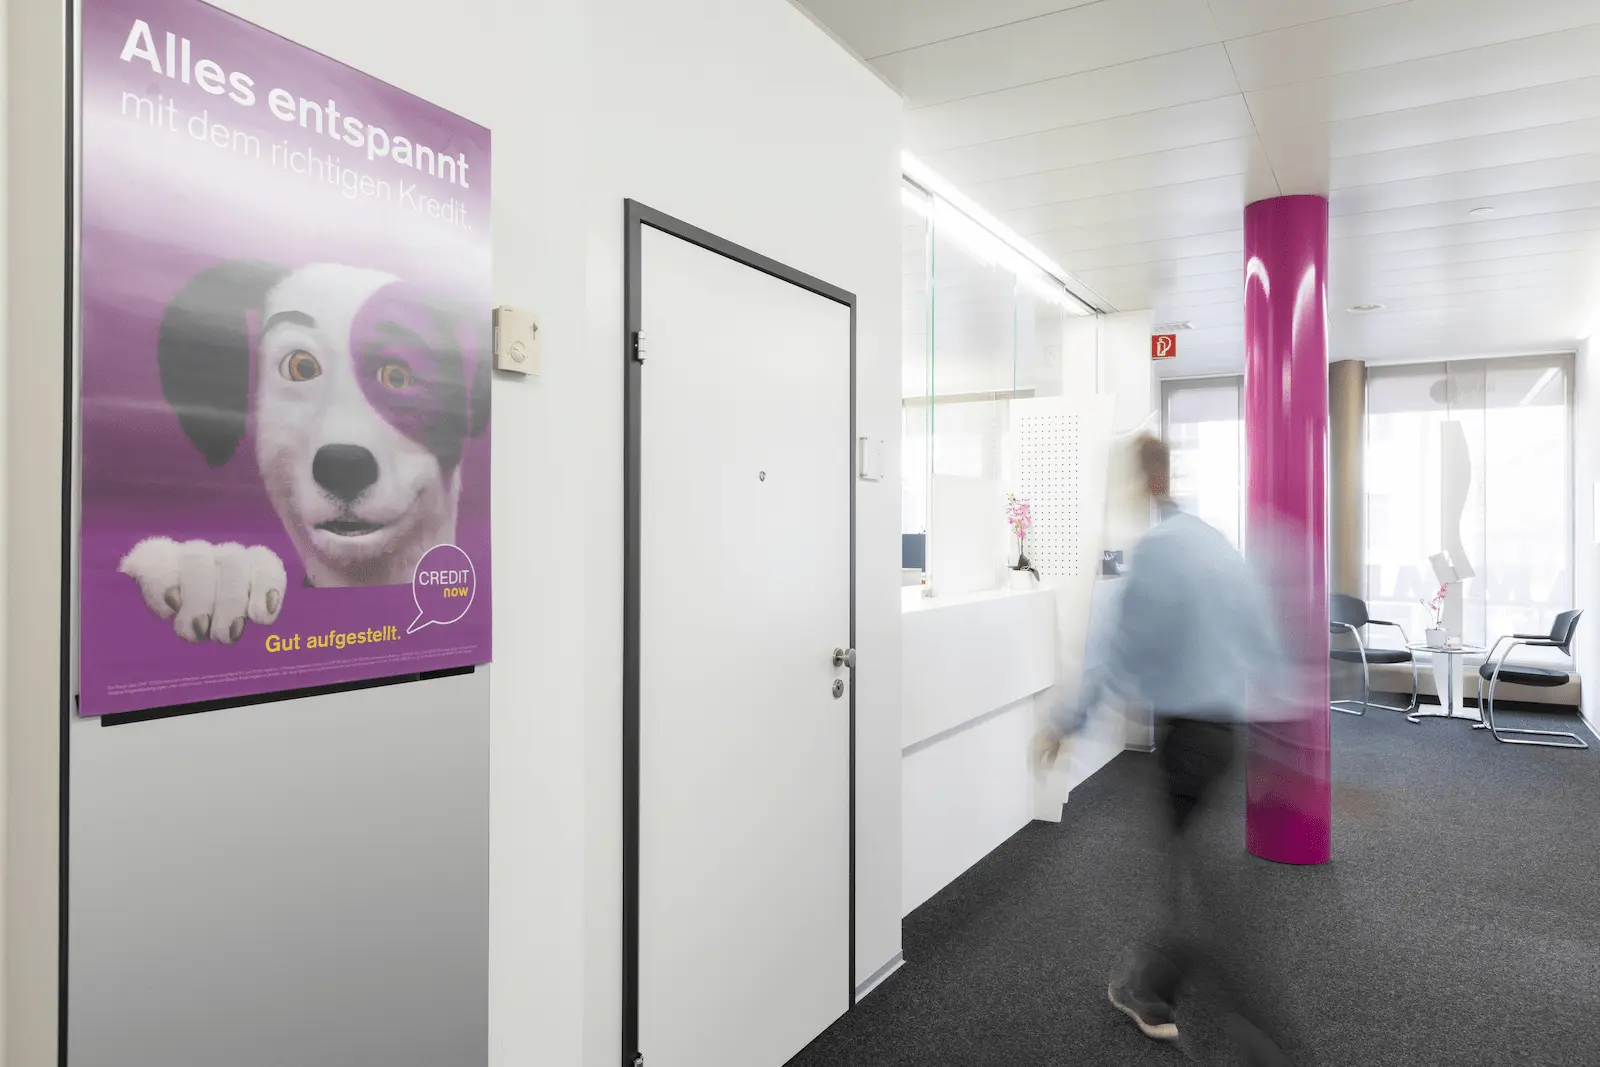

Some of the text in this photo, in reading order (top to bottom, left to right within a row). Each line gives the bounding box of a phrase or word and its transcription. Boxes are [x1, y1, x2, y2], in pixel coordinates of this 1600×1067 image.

[119, 18, 470, 189] Alles entspannt
[121, 91, 473, 231] mit dem richtigen Kredit.
[418, 569, 470, 586] CREDIT
[443, 586, 469, 599] now
[265, 625, 402, 653] Gut aufgestellt.
